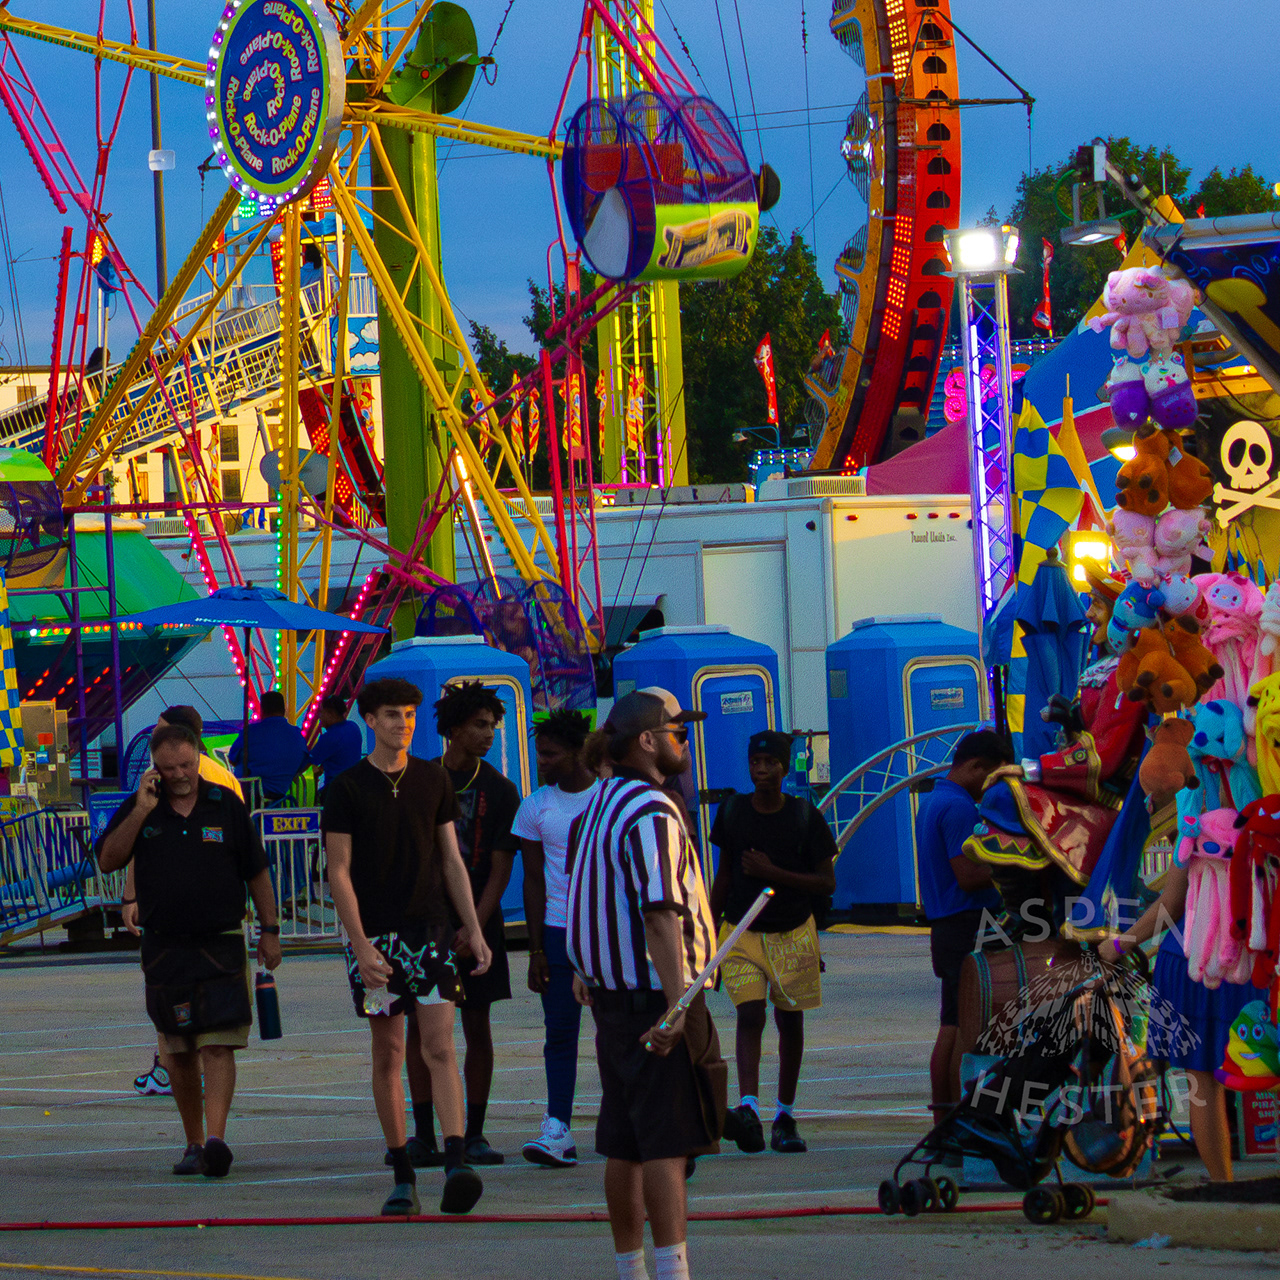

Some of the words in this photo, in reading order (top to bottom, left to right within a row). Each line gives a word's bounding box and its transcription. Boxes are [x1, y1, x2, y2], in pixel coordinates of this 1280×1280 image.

[240, 29, 303, 83] Rock-O-Plane
[263, 1, 320, 73] Rock-O-Plane
[243, 58, 286, 119] Rock-O-Plane
[225, 75, 264, 173] Rock-O-Plane
[243, 95, 302, 148] Rock-O-Plane
[271, 87, 320, 176] Rock-O-Plane
[272, 816, 311, 832] EXIT
